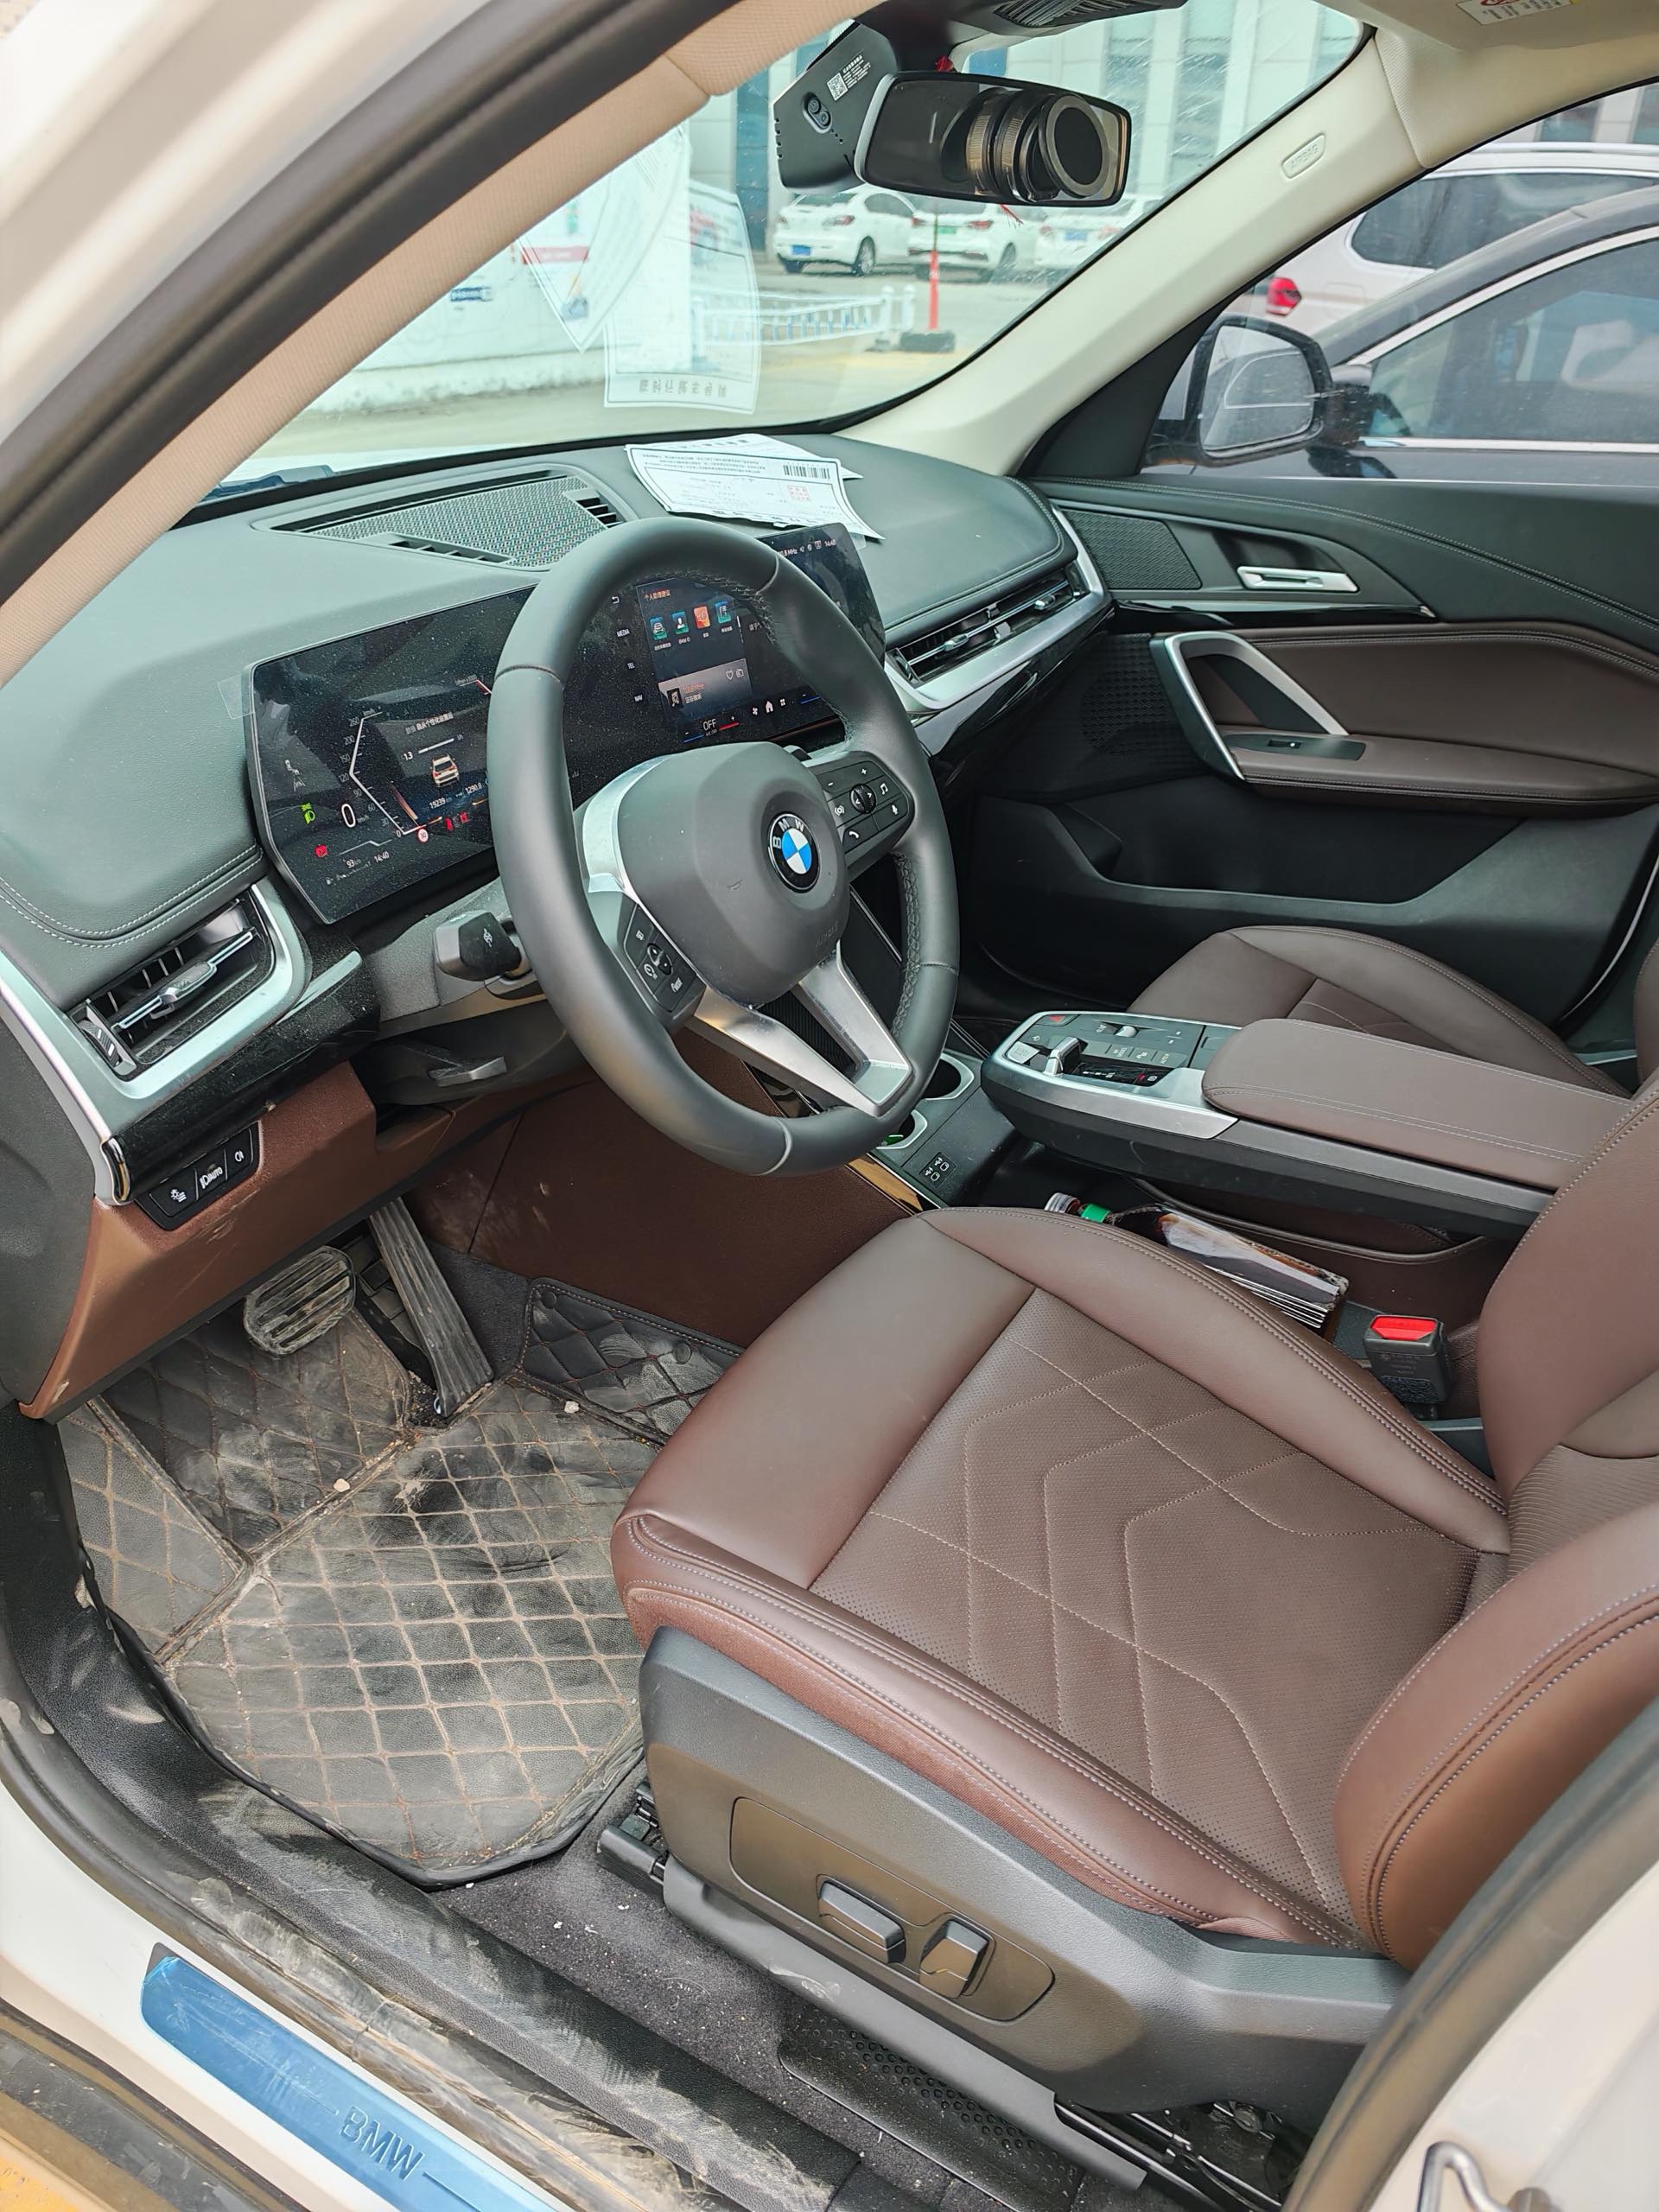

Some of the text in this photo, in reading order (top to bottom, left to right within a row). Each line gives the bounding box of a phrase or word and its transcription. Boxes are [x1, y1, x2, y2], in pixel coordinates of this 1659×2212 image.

[616, 628, 631, 638] MEDIA
[702, 718, 717, 731] OFF
[429, 797, 446, 810] 19239
[340, 803, 356, 828] 0
[772, 817, 805, 849] BMW
[373, 850, 390, 863] 14:40
[207, 1166, 224, 1184] AUTO
[342, 2105, 426, 2183] BMW
